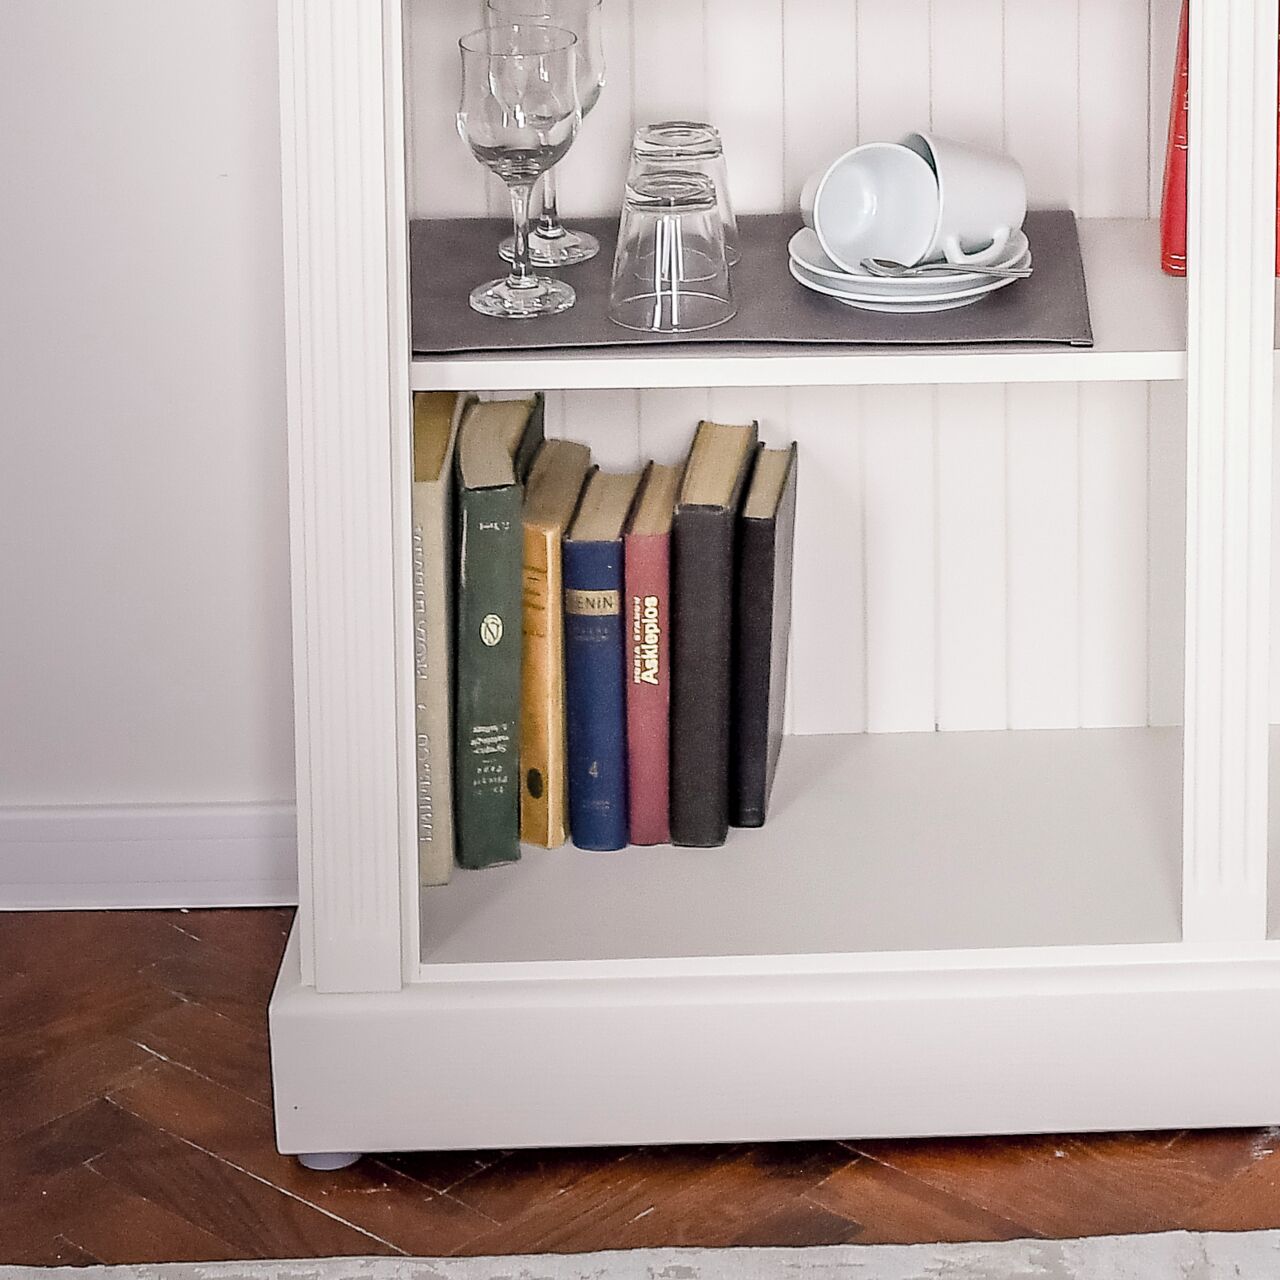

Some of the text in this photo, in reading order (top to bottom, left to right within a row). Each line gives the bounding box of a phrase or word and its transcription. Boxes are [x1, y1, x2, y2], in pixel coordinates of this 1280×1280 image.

[571, 596, 614, 610] ENIN
[640, 595, 661, 686] Asklepios
[588, 760, 599, 779] 4
